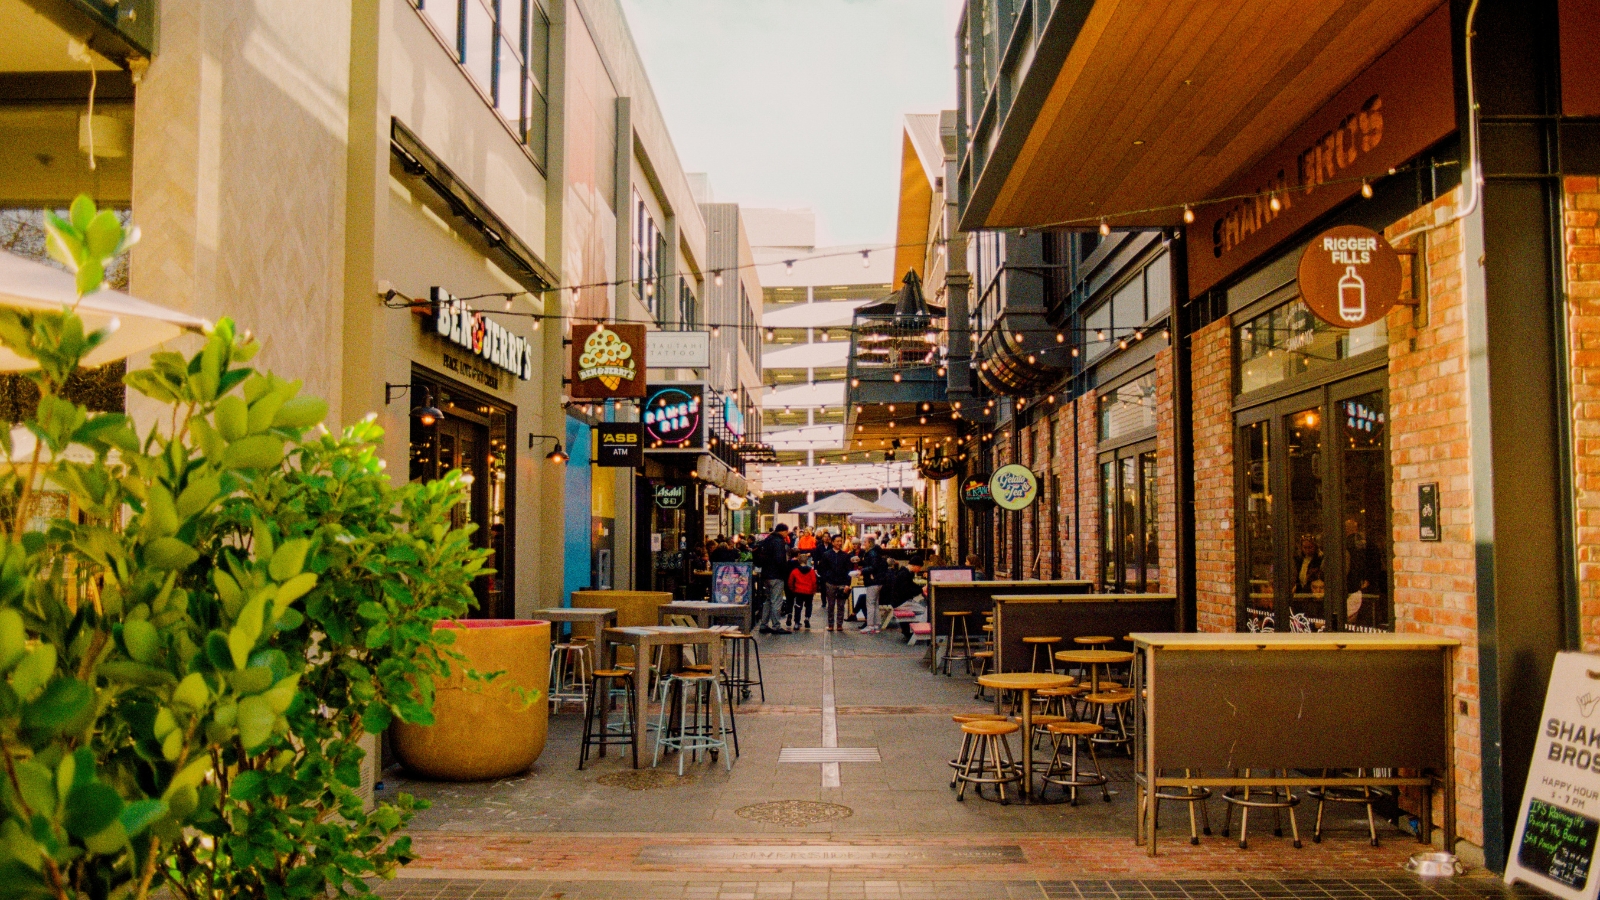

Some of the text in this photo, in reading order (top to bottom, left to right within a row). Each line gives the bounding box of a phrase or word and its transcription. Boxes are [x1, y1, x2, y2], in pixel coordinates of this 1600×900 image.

[1323, 238, 1377, 251] RIGGER
[1332, 251, 1371, 264] FILLS
[643, 400, 699, 425] RAMEN
[659, 415, 690, 433] RIA
[612, 448, 628, 456] ATM
[657, 486, 682, 497] Asahi
[1005, 483, 1023, 501] Tea
[1541, 776, 1600, 801] HAPPY HOUR
[1571, 797, 1585, 810] PM
